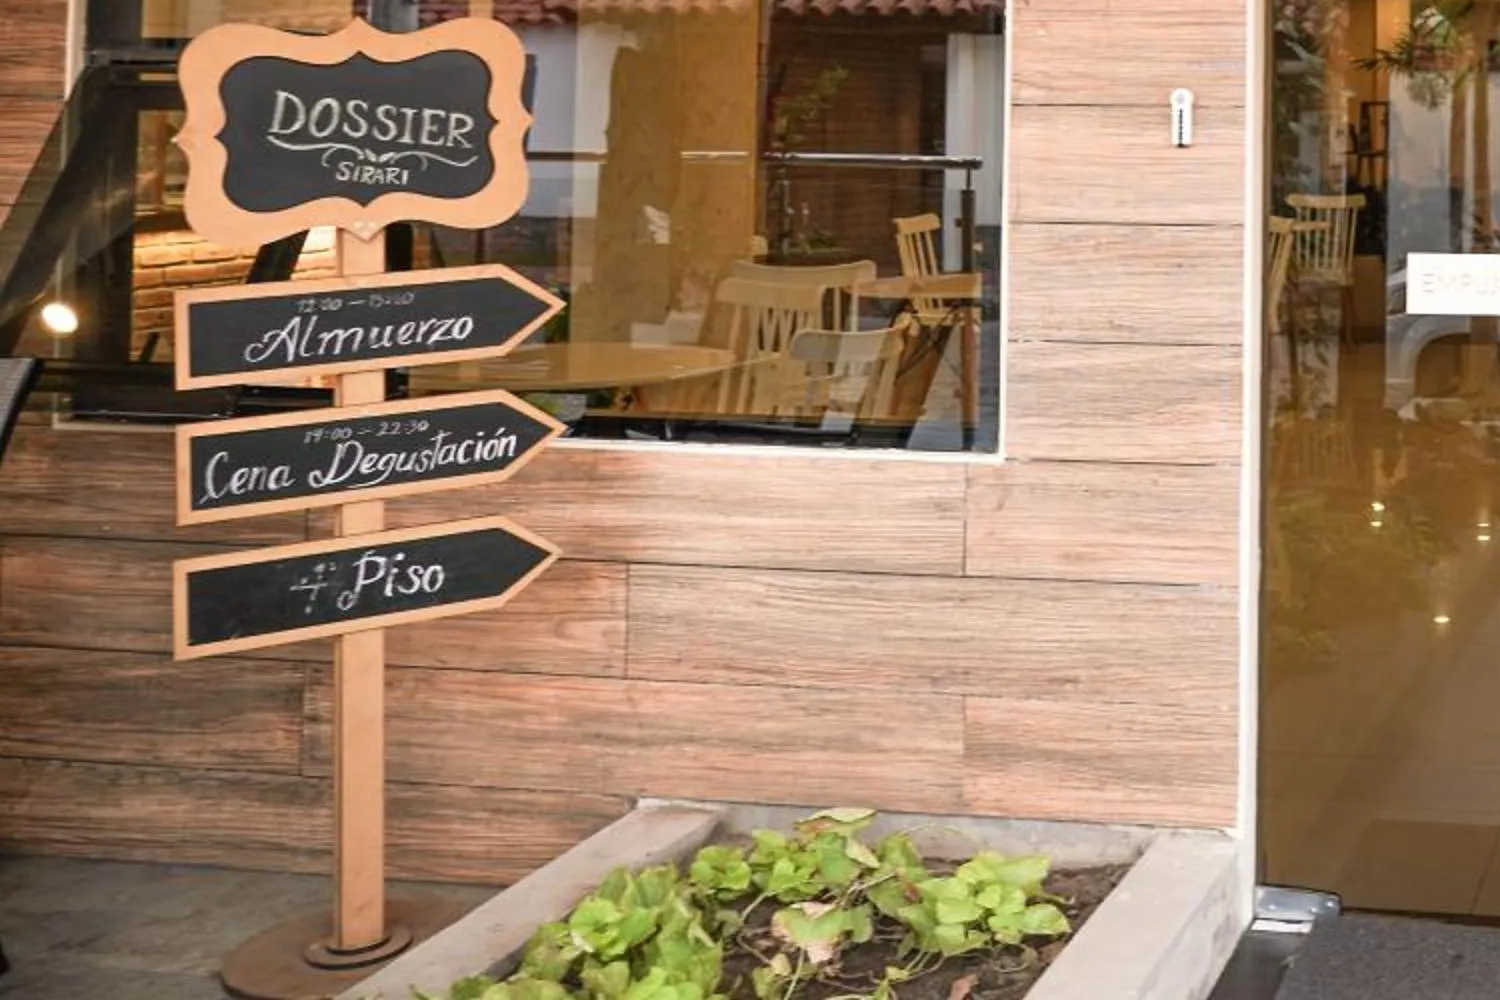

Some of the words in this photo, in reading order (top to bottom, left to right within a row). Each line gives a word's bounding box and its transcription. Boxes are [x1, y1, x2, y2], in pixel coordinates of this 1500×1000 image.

[267, 89, 474, 149] DOSSIER
[335, 161, 409, 185] SIRARI
[244, 313, 473, 363] Almuerzo
[200, 451, 296, 504] Cena
[307, 428, 517, 488] Degustación
[336, 549, 445, 612] Piso
